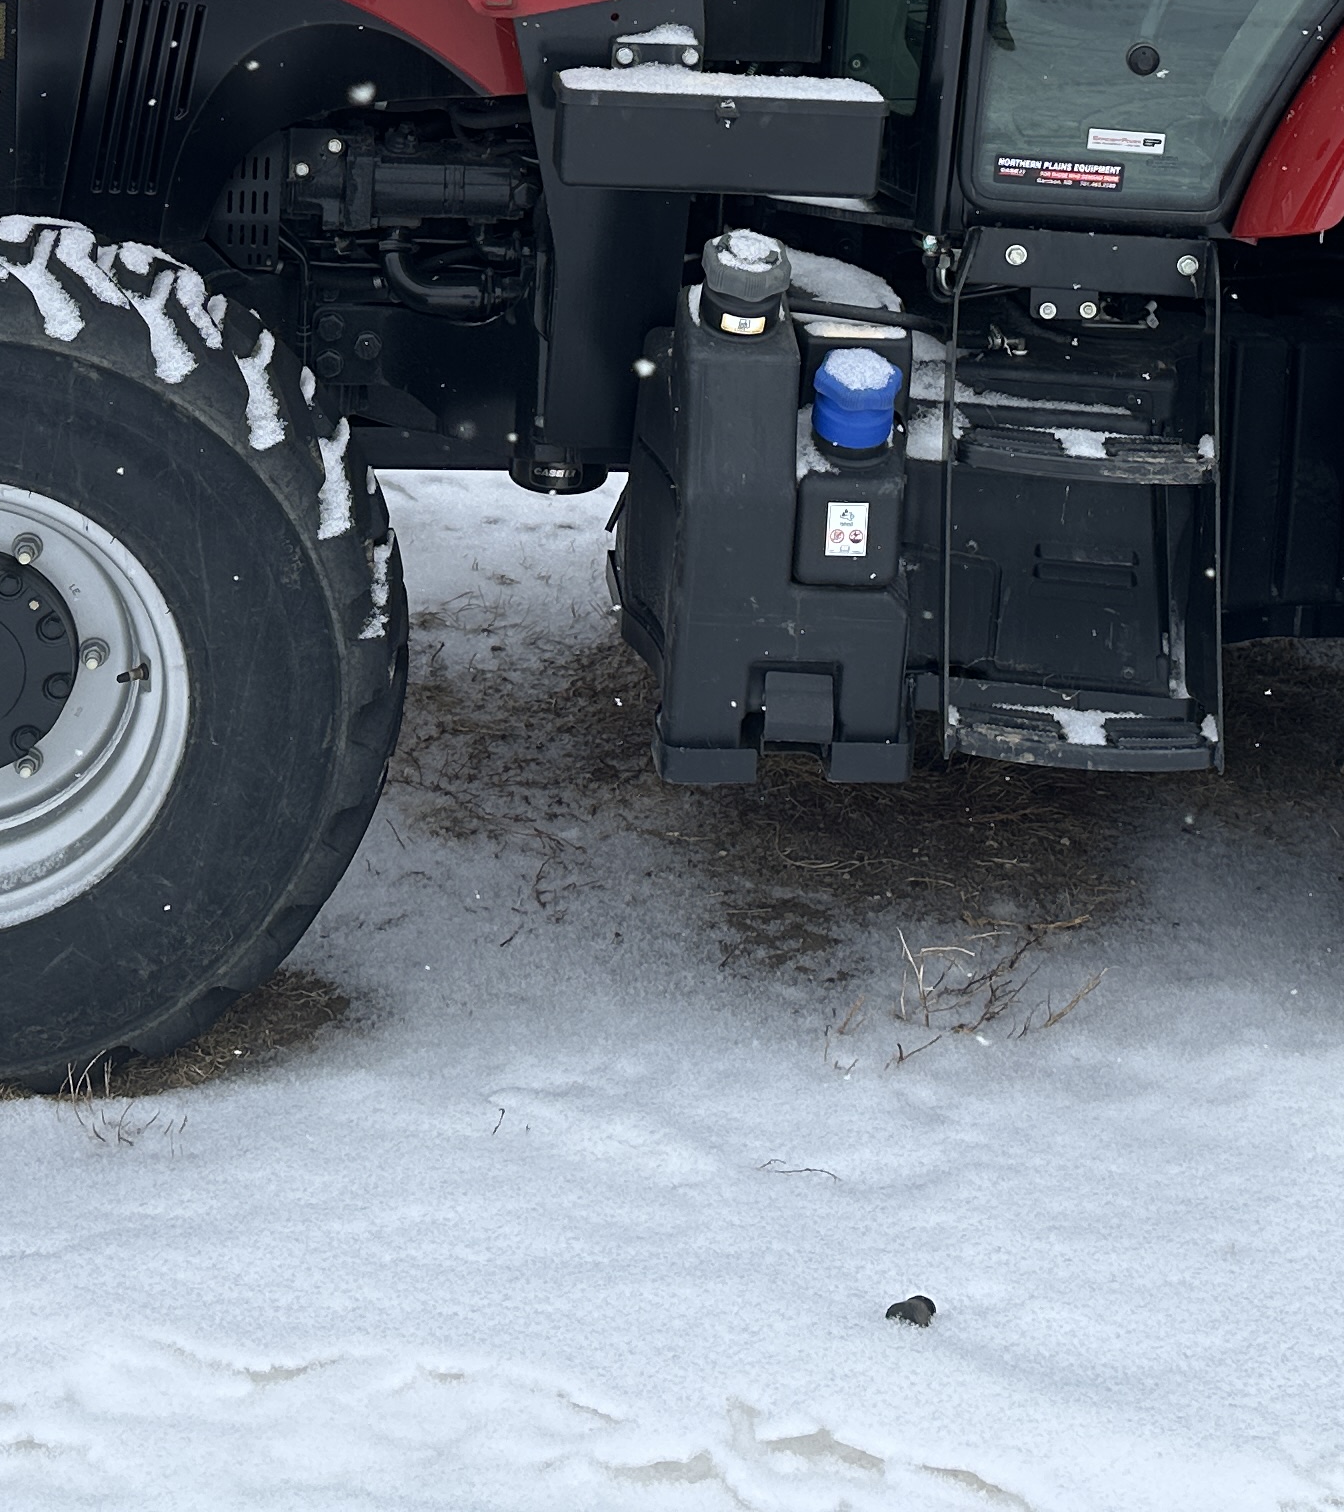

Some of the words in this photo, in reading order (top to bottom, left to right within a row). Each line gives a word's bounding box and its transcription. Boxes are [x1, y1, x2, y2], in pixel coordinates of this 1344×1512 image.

[998, 157, 1043, 169] NORTHERN
[1043, 161, 1073, 172] PLAINS
[1073, 163, 1122, 175] EQUIPMENT
[534, 468, 564, 477] CASE
